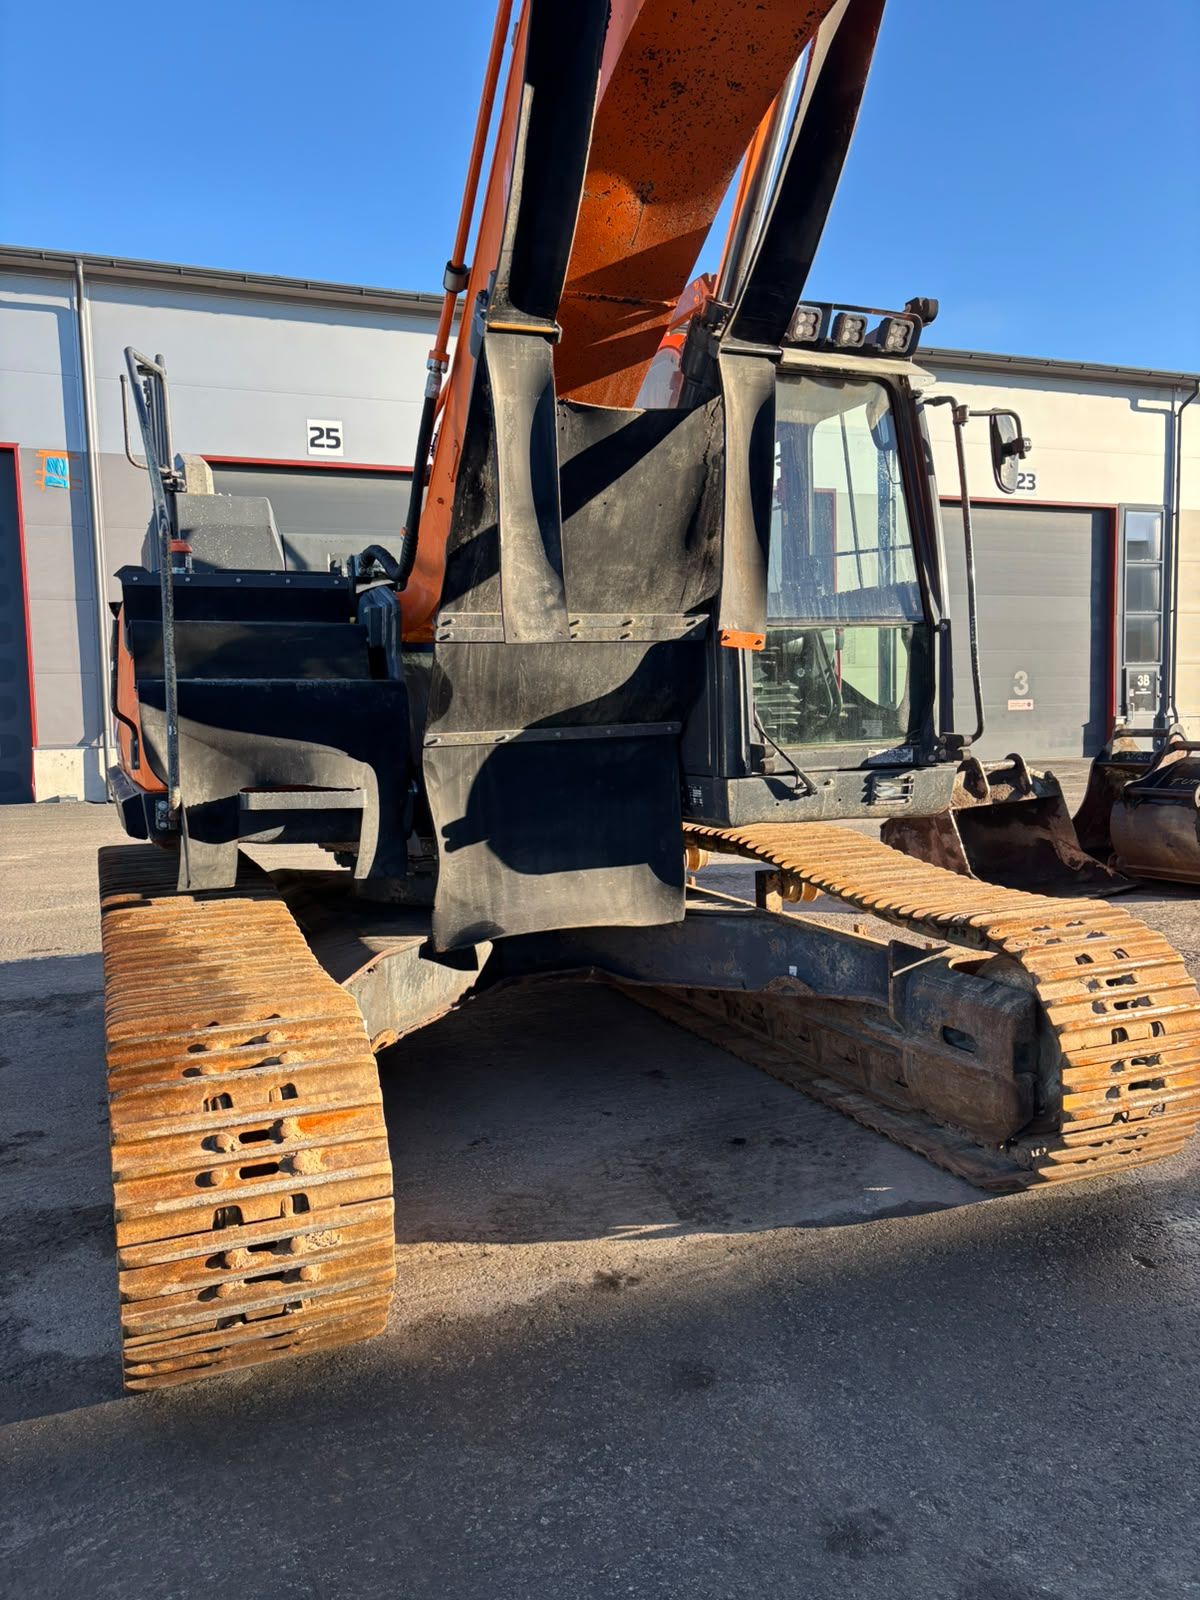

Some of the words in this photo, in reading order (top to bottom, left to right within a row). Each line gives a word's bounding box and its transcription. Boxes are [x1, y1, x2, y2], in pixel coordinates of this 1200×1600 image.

[309, 426, 341, 449] 25
[1016, 473, 1036, 490] 23
[1013, 670, 1029, 696] 3
[1137, 674, 1150, 687] 3B
